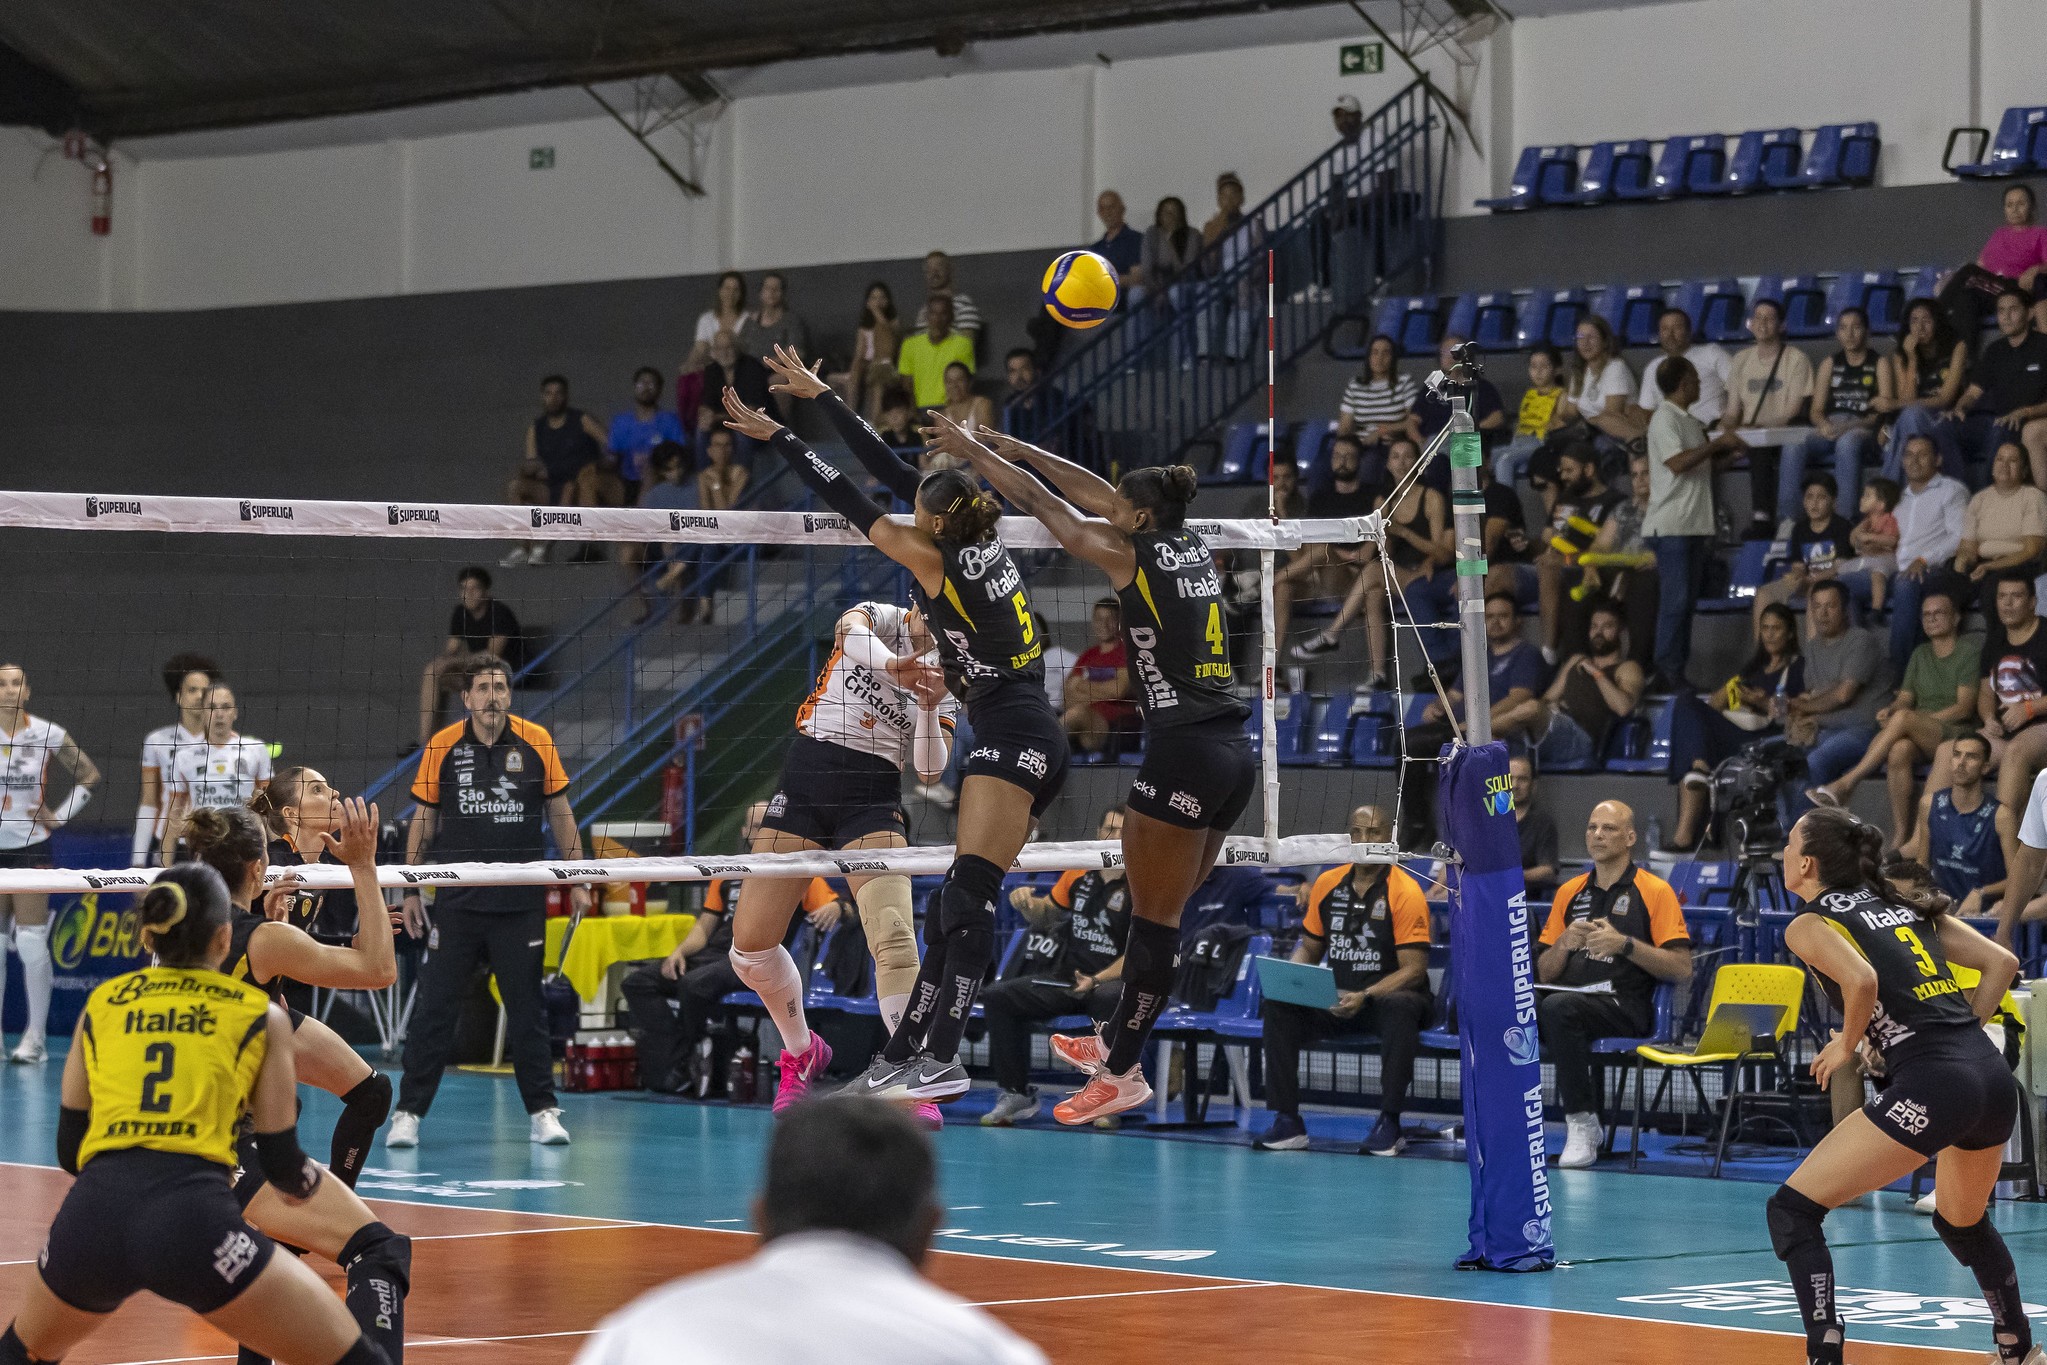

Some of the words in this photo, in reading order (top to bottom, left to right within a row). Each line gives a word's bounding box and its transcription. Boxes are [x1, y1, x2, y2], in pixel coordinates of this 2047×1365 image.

[804, 450, 840, 481] Dentil
[99, 501, 142, 516] SUPERLIGA
[252, 505, 293, 520] SUPERLIGA
[400, 509, 440, 523] SUPERLIGA
[543, 512, 581, 526] SUPERLIGA
[681, 516, 718, 530] SUPERLIGA
[814, 517, 851, 531] SUPERLIGA
[1012, 591, 1034, 645] 5
[1205, 602, 1224, 655] 4
[851, 664, 882, 692] São
[1129, 626, 1179, 709] Dentil
[844, 675, 912, 730] Cristóvão
[1019, 751, 1048, 775] PRO
[458, 788, 486, 802] São
[459, 799, 525, 814] Cristóvão
[1170, 792, 1202, 813] PRO
[848, 860, 890, 871] SUPERLIGA
[1235, 850, 1270, 864] SUPERLIGA
[100, 876, 148, 886] SUPERLIGA
[413, 870, 460, 881] SUPERLIGA
[565, 867, 608, 877] SUPERLIGA
[1330, 933, 1351, 948] São
[1894, 926, 1938, 977] 3
[1329, 946, 1381, 961] Cristóvão
[1352, 960, 1381, 972] saúde
[1509, 891, 1537, 1025] SUPERLIGA
[910, 980, 936, 1024] Dentil
[949, 974, 971, 1020] Dentil
[125, 1003, 218, 1036] Italac
[1127, 991, 1155, 1030] Dentil
[140, 1042, 176, 1113] 2
[1885, 1109, 1923, 1136] PLAY
[1890, 1100, 1930, 1129] PRO
[1523, 1083, 1552, 1217] SUPERLIGA
[369, 1279, 392, 1330] Dentil
[1811, 1273, 1827, 1322] Dentil
